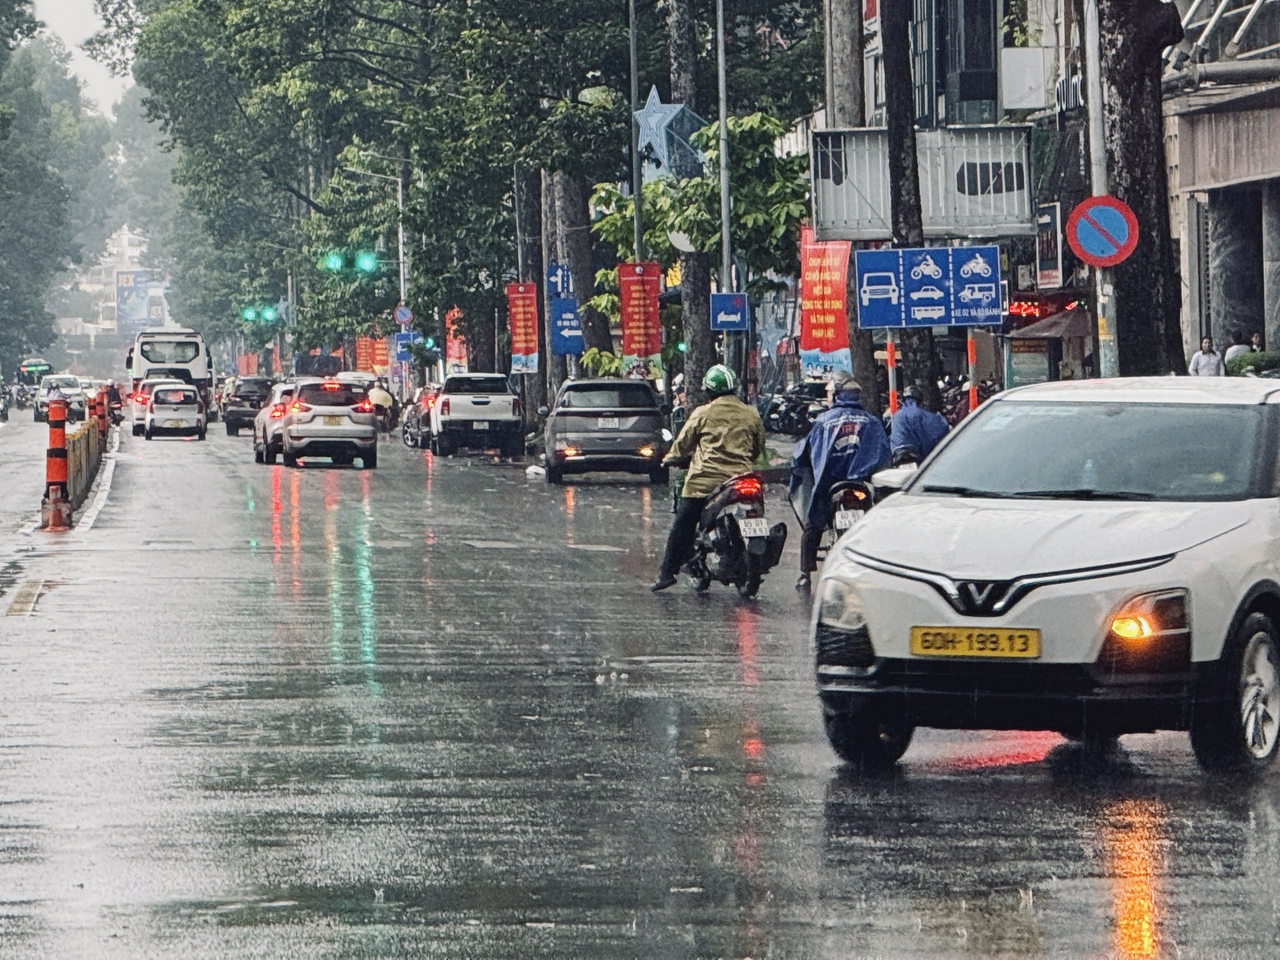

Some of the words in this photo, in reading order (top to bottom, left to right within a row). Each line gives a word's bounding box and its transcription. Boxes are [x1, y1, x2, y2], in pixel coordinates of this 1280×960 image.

[118, 274, 134, 287] JEX
[955, 307, 961, 316] XE
[962, 307, 969, 316] 02
[970, 306, 978, 316] VÀ
